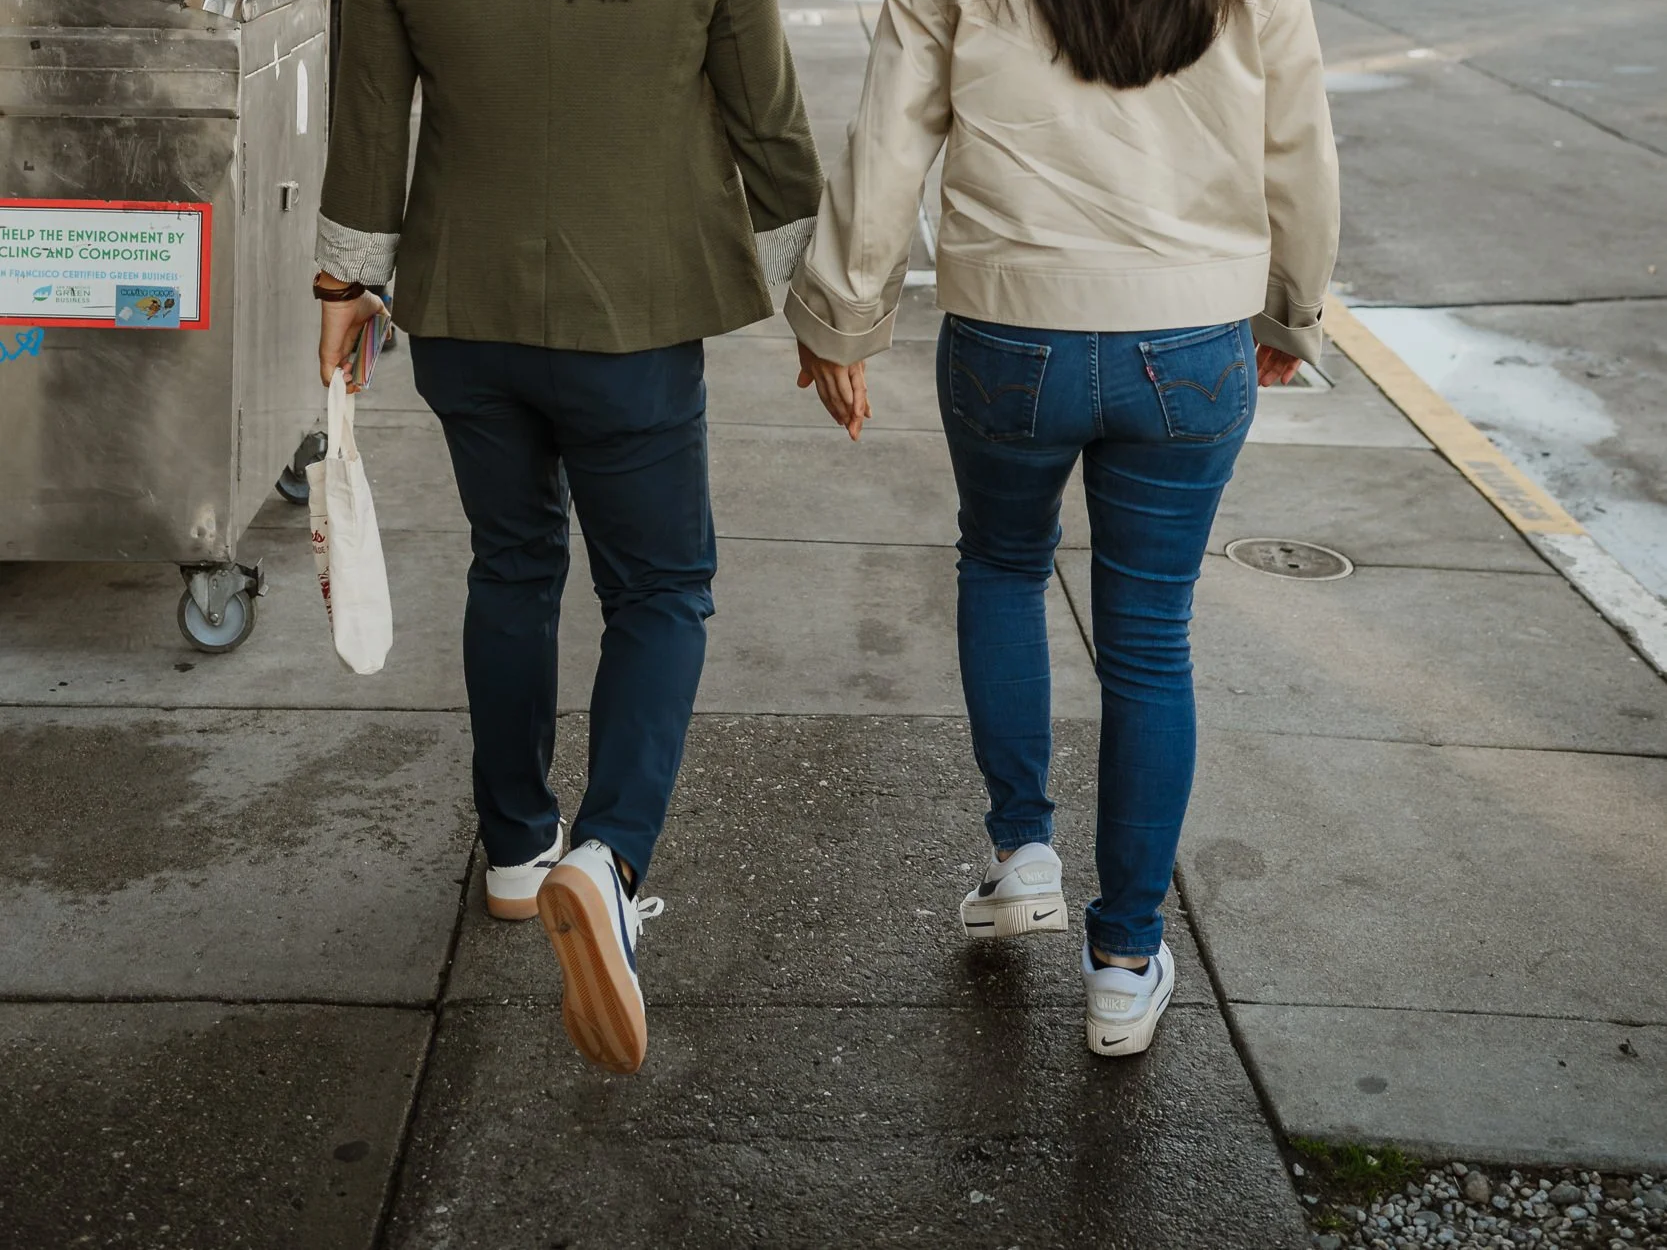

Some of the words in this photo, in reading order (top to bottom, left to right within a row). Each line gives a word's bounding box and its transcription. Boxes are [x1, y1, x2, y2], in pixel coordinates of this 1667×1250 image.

[2, 229, 35, 241] HELP
[40, 229, 63, 242] THE
[68, 230, 163, 243] ENVIRONMENT
[168, 232, 185, 244] BY
[46, 248, 74, 259] AND
[79, 248, 171, 261] COMPOSTING
[9, 269, 60, 279] FRANCISCO
[62, 270, 106, 279] CERTIFIED
[109, 271, 139, 280] GREEN
[142, 272, 178, 281] BUSINESS
[1025, 870, 1050, 881] NIKE
[1100, 997, 1127, 1010] NIKE
